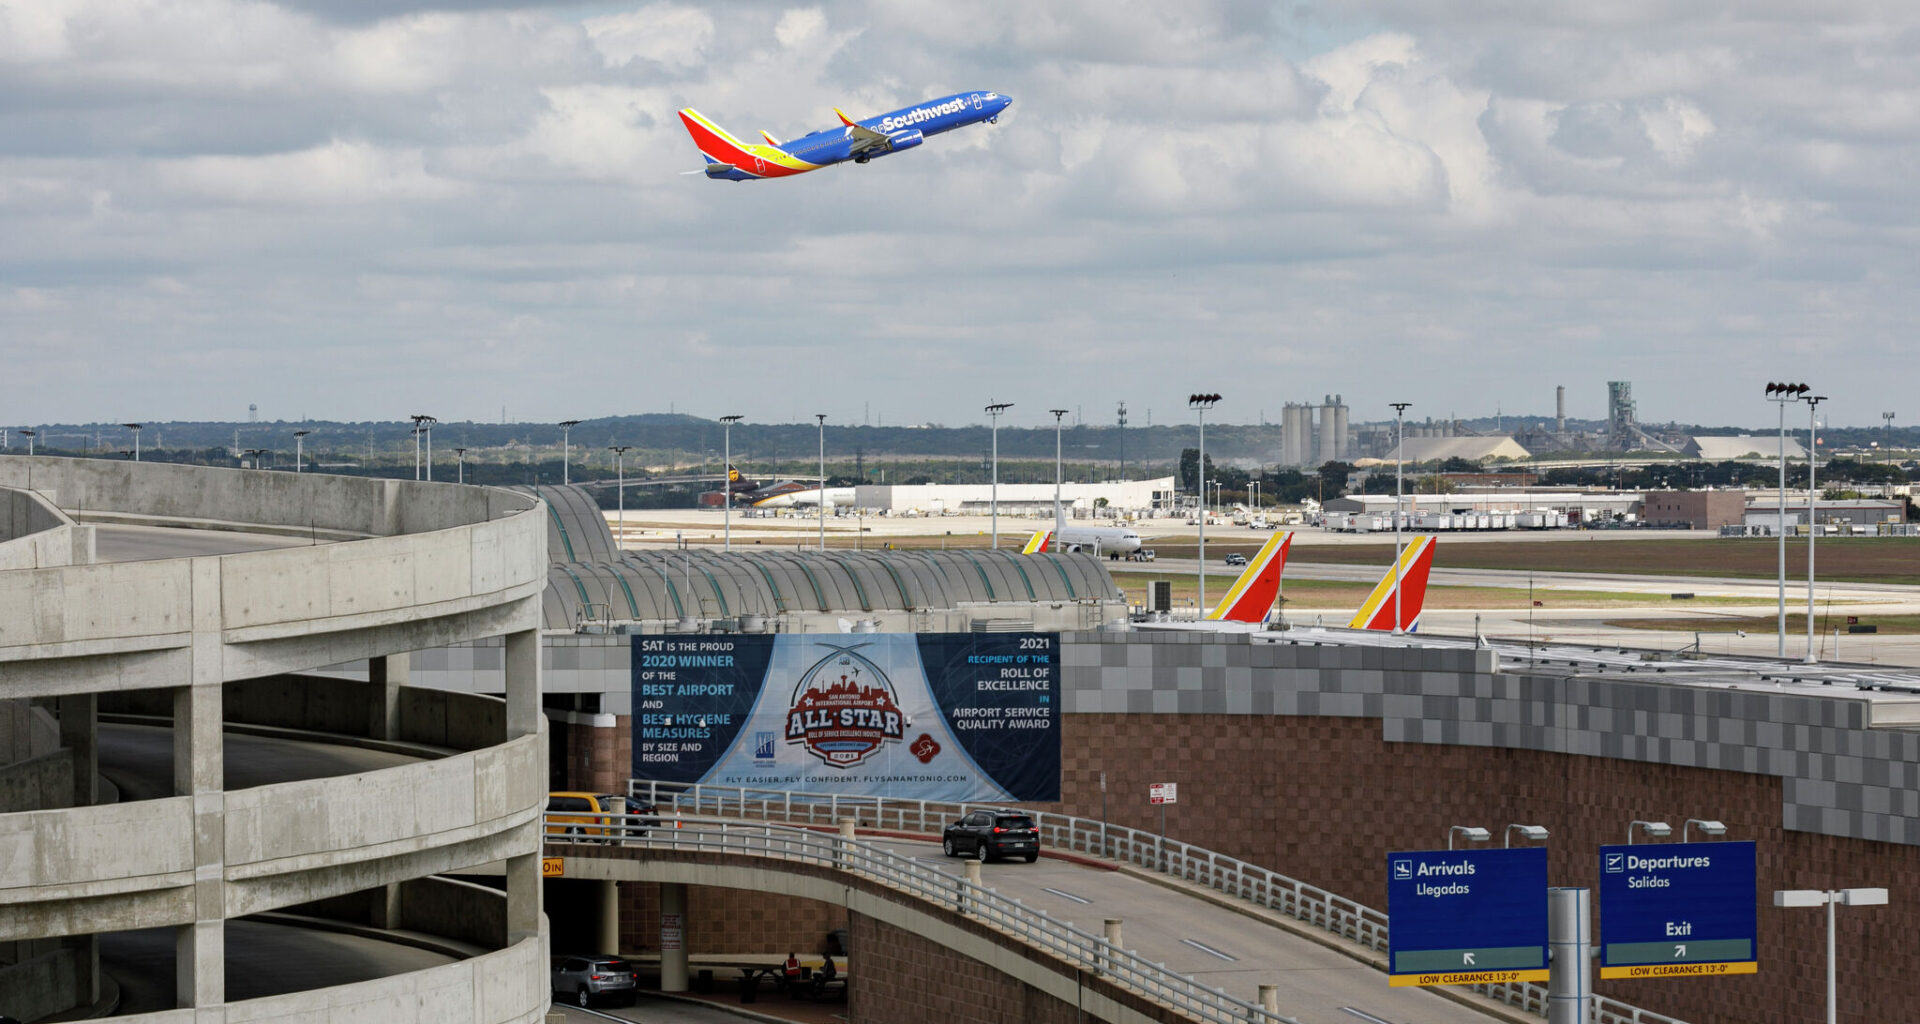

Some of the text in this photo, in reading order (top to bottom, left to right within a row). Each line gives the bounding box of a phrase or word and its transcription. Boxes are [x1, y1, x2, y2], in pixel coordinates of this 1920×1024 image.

[882, 97, 966, 131] Southwest
[642, 640, 734, 651] SAT IS THE PROUD
[1019, 638, 1050, 649] 2021
[643, 655, 734, 667] 2020 WINNER
[968, 655, 1049, 664] RECIPIENT OF THE
[642, 671, 676, 681] OF THE
[1000, 668, 1050, 678] ROLL OF
[642, 684, 734, 696] BEST AIRPORT
[977, 680, 1050, 691] EXCELLENCE
[642, 700, 664, 709] AND
[1039, 695, 1050, 704] IN
[953, 708, 1050, 718] AIRPORT SERVICE
[643, 713, 731, 725] BEST HYGIENE
[788, 709, 899, 736] ALL STAR
[957, 719, 1050, 730] QUALITY AWARD
[643, 727, 711, 739] MEASURES
[643, 743, 702, 752] BY SIZE AND
[643, 753, 679, 763] REGION
[864, 775, 967, 783] FLYSANANTONIO.COM
[1416, 860, 1476, 876] Arrivals
[1627, 855, 1711, 872] Departures
[1627, 876, 1670, 889] Salidas
[1416, 882, 1470, 898] Llegadas
[1665, 921, 1692, 936] Exit
[1630, 967, 1650, 976] LOW
[1652, 966, 1705, 976] CLEARANCE
[1419, 975, 1440, 985] LOW
[1442, 973, 1495, 984] CLEARANCE
